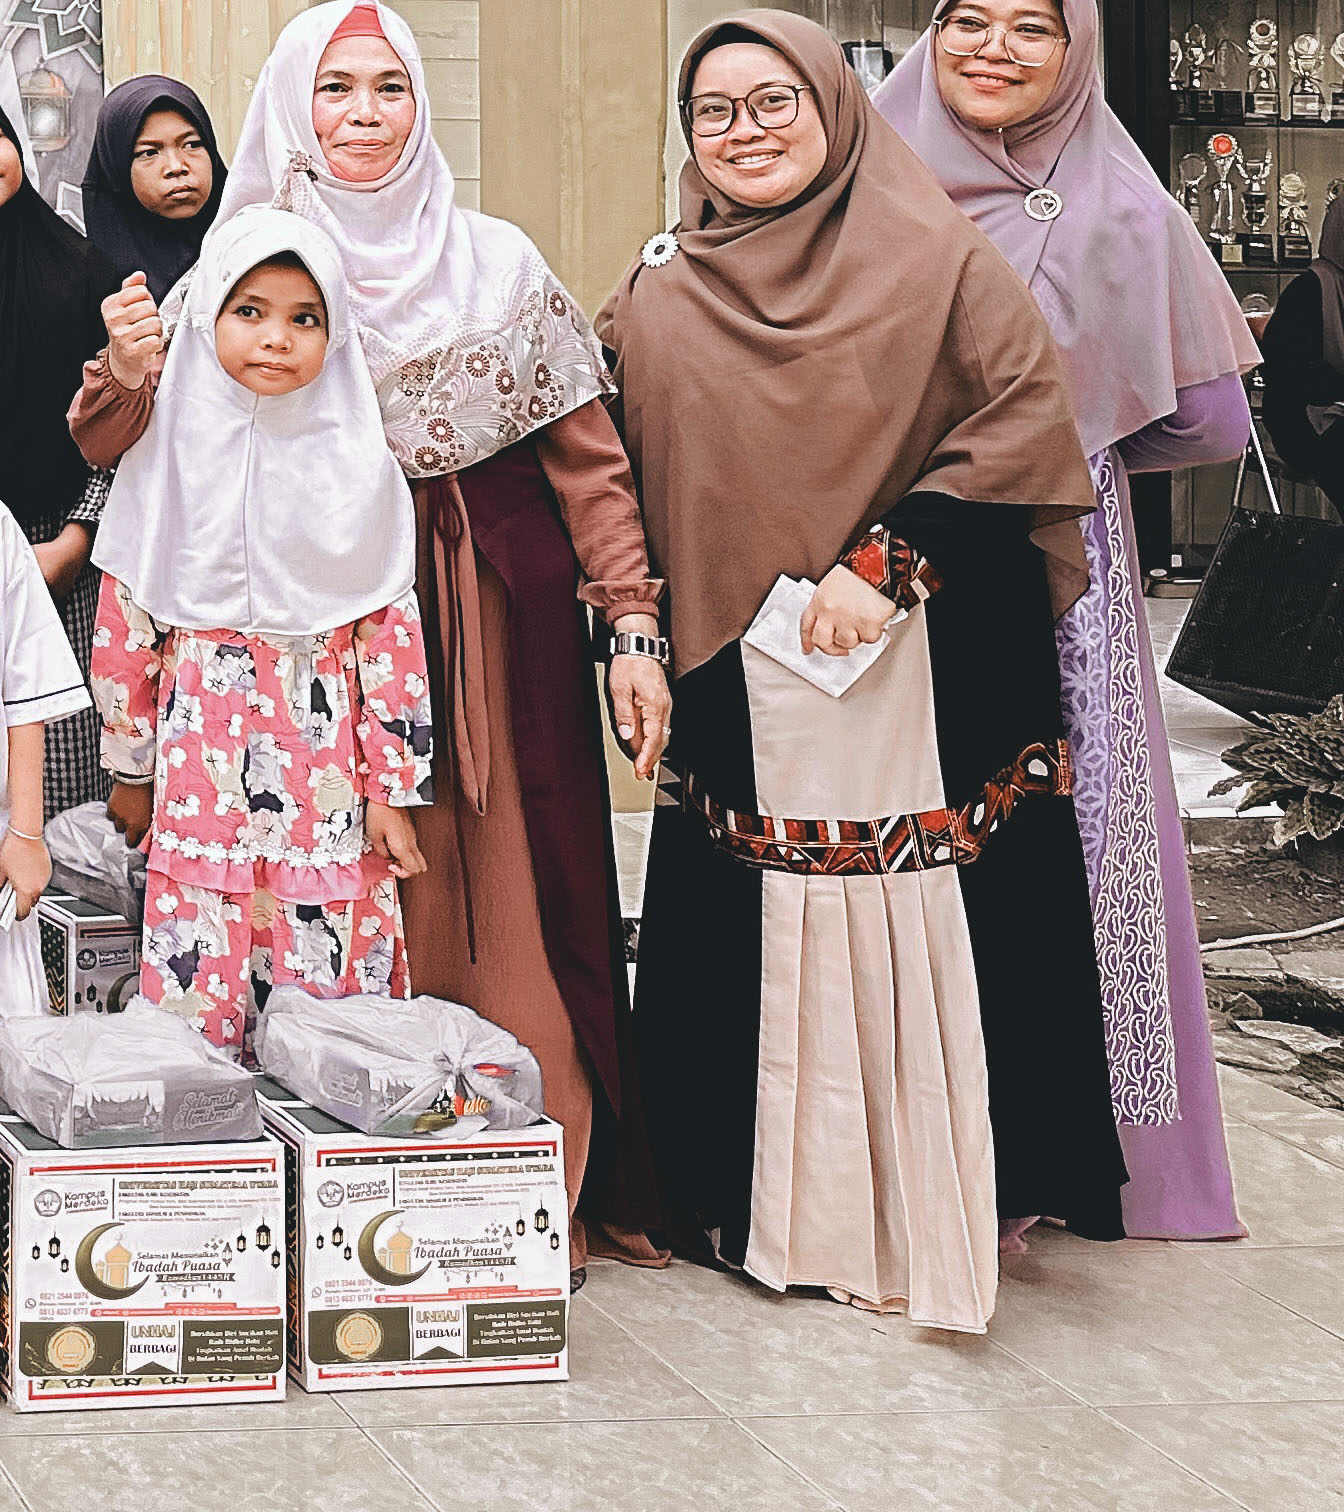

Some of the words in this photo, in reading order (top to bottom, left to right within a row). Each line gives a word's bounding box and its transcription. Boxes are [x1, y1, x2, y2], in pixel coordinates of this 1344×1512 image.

[346, 1179, 387, 1192] Kampus
[64, 1190, 106, 1202] Kampus
[346, 1186, 390, 1198] Merdeka
[64, 1197, 109, 1208] Merdeka
[413, 1245, 460, 1259] Ibadah
[462, 1243, 502, 1258] Puasa
[131, 1260, 178, 1273] Ibadah
[180, 1259, 220, 1272] Puasa
[415, 1328, 461, 1340] BERBAGI
[130, 1344, 176, 1354] BERBAGI
